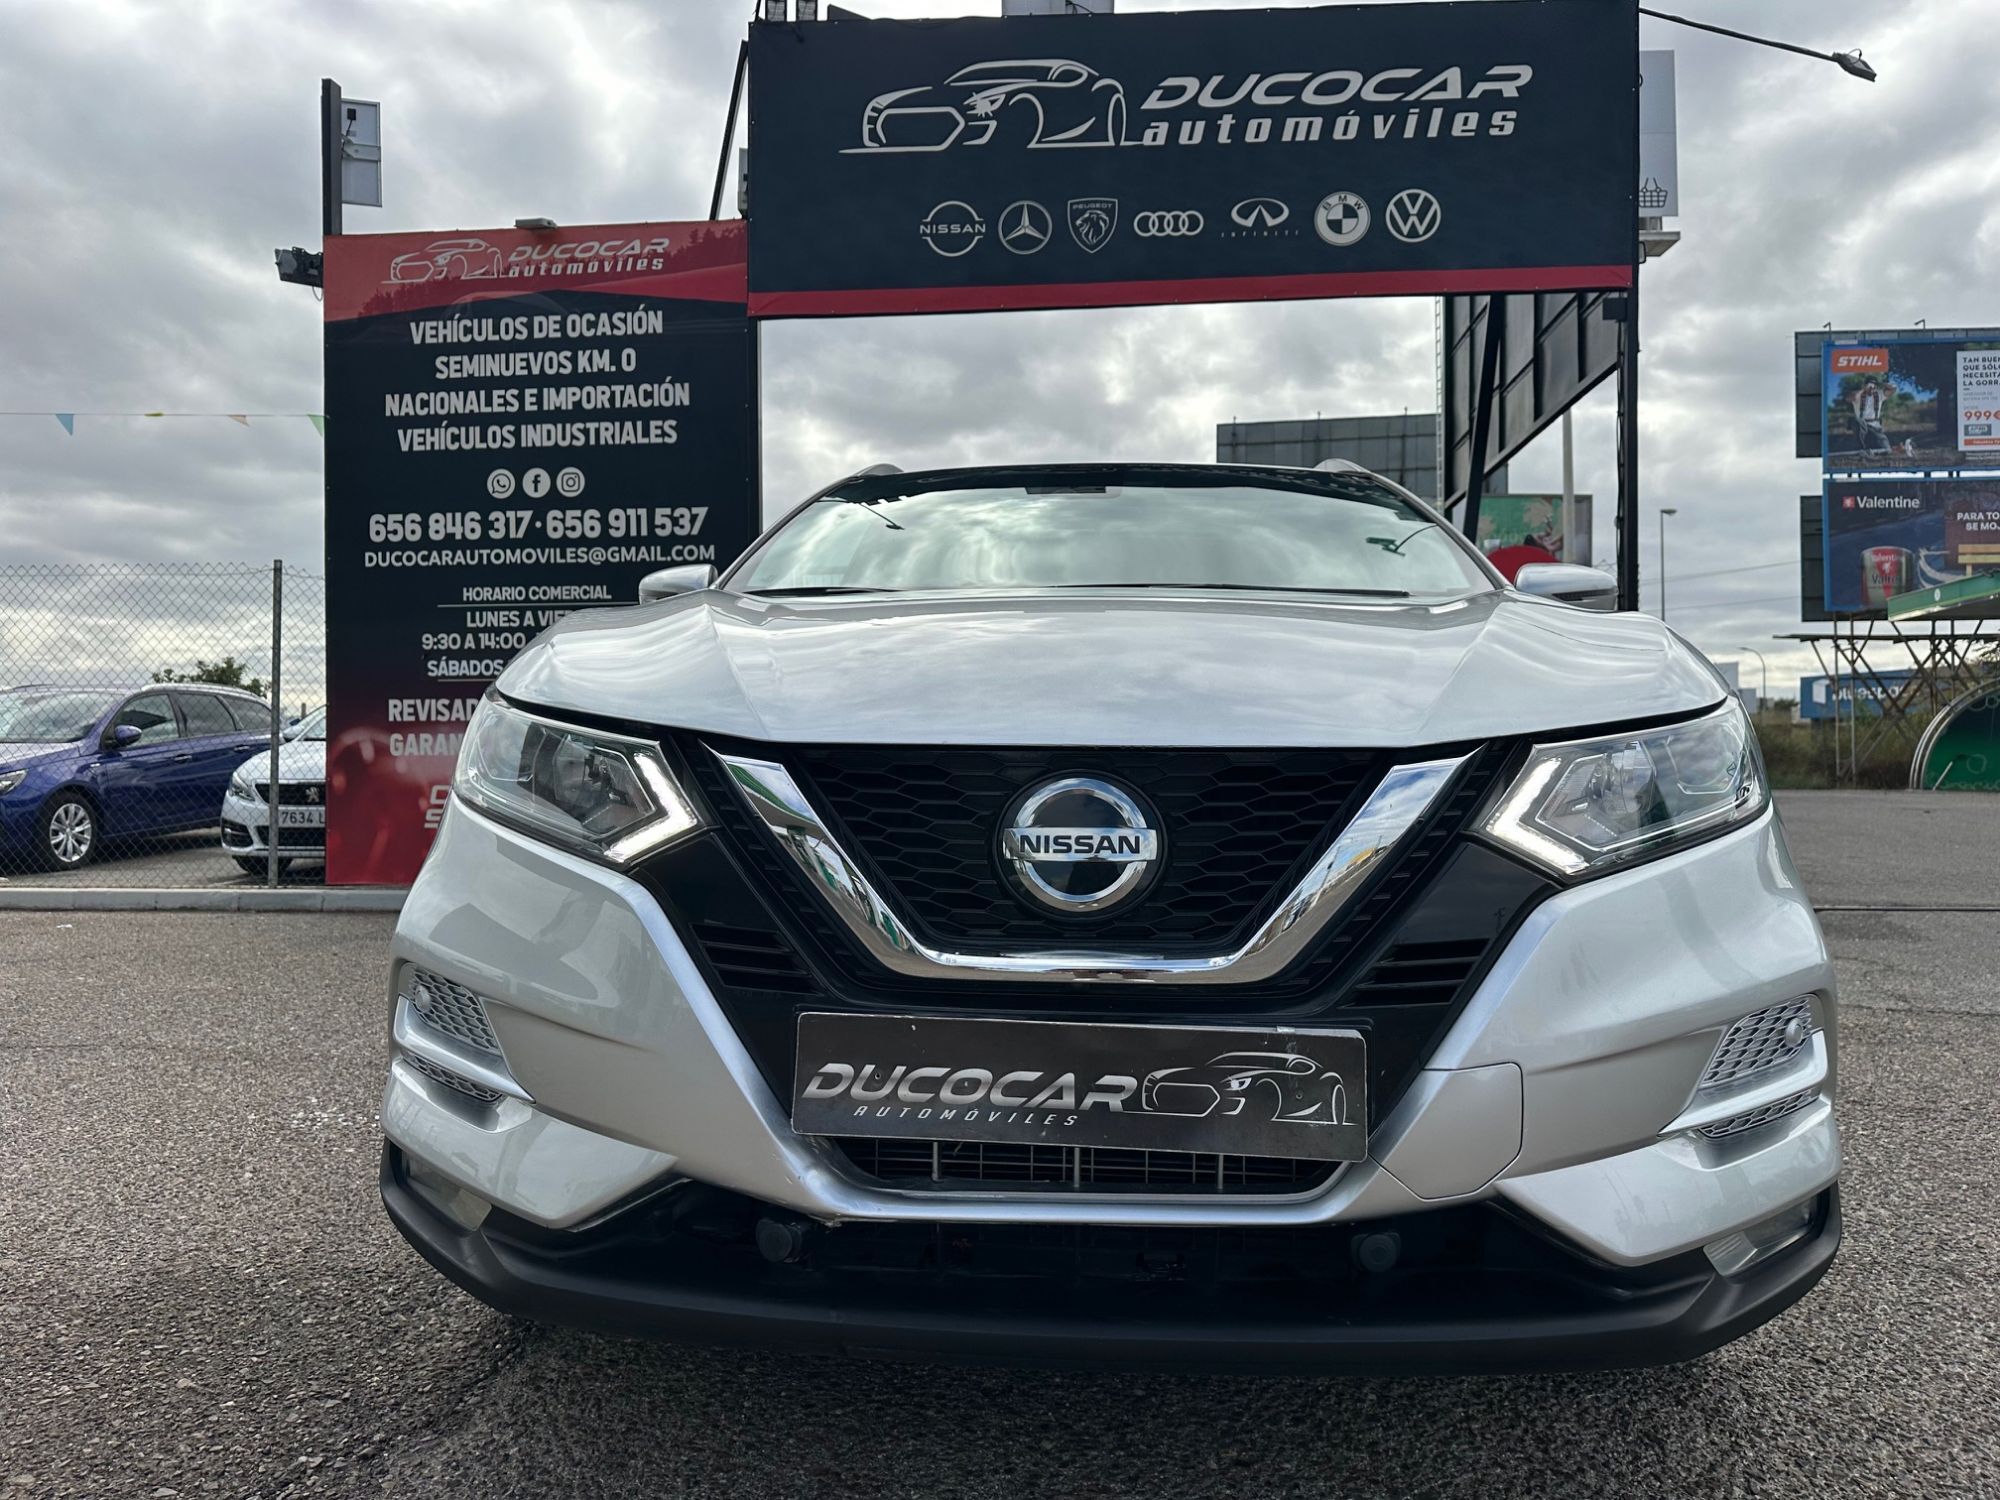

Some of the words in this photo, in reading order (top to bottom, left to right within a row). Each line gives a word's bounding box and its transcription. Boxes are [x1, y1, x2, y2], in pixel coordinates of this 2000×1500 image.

[1140, 64, 1533, 110] DUCOCAR
[1142, 108, 1517, 146] automóviles
[920, 223, 986, 234] NISSAN
[508, 238, 670, 262] DUCOCAR
[508, 257, 664, 278] automóviles
[410, 314, 528, 344] VEHÍCULOS
[534, 314, 561, 339] DE
[566, 304, 663, 337] OCASIÓN
[435, 351, 572, 379] SEMINUEVOS
[577, 349, 616, 374] KM.
[1837, 355, 1882, 367] STIHL
[385, 389, 519, 417] NACIONALES
[525, 389, 538, 411] E
[543, 377, 690, 410] IMPORTACIÓN
[398, 421, 516, 452] VEHÍCULOS
[521, 420, 678, 448] INDUSTRIALES
[1857, 495, 1920, 509] Valentine
[369, 513, 422, 543] 656
[428, 511, 482, 541] 846
[608, 508, 649, 538] 911
[654, 507, 709, 536] 537
[1957, 512, 1985, 520] PARA
[1966, 522, 1979, 531] SE
[365, 545, 715, 568] DUCOCARAUTOMOVILES@GMAIL.COM
[463, 586, 525, 601] HORARIO
[528, 585, 612, 600] COMERCIAL
[467, 610, 520, 628] LUNES
[523, 610, 535, 627] A
[422, 632, 461, 650] 9:30
[464, 633, 475, 649] A
[478, 632, 526, 649] 14:00
[427, 656, 504, 677] SÁBADOS
[281, 811, 314, 824] 7634
[1020, 834, 1142, 855] NISSAN
[802, 1062, 1138, 1112] DUCOCAR
[853, 1104, 1079, 1127] AUTOMÓVILES
